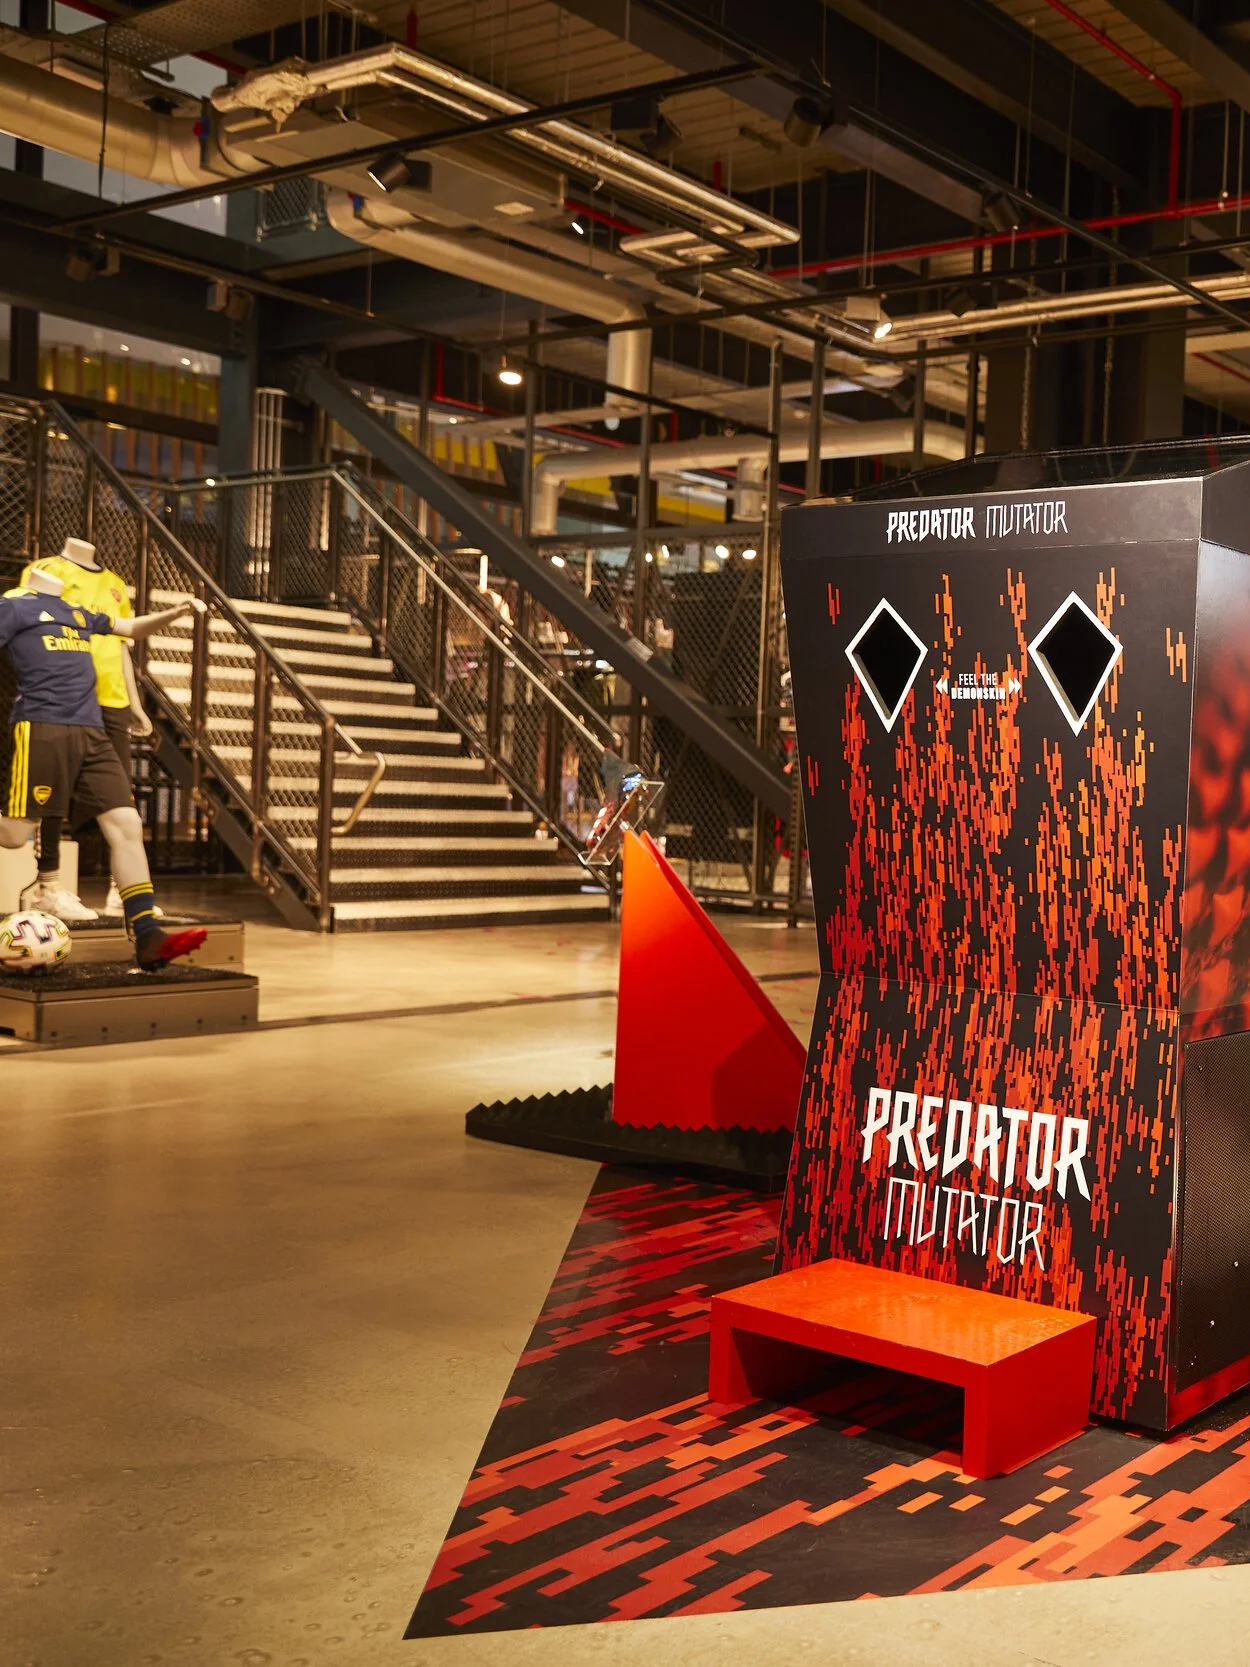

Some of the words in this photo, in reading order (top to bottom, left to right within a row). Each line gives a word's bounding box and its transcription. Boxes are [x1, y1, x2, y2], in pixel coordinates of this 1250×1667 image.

[886, 507, 976, 544] PREDATOR
[985, 501, 1069, 539] MUTATOR
[951, 687, 1006, 700] DEMONSKIN
[958, 673, 979, 686] FEEL
[980, 673, 997, 685] THE
[860, 1087, 1091, 1202] PREDATOR
[883, 1176, 1045, 1271] MUTATOR
